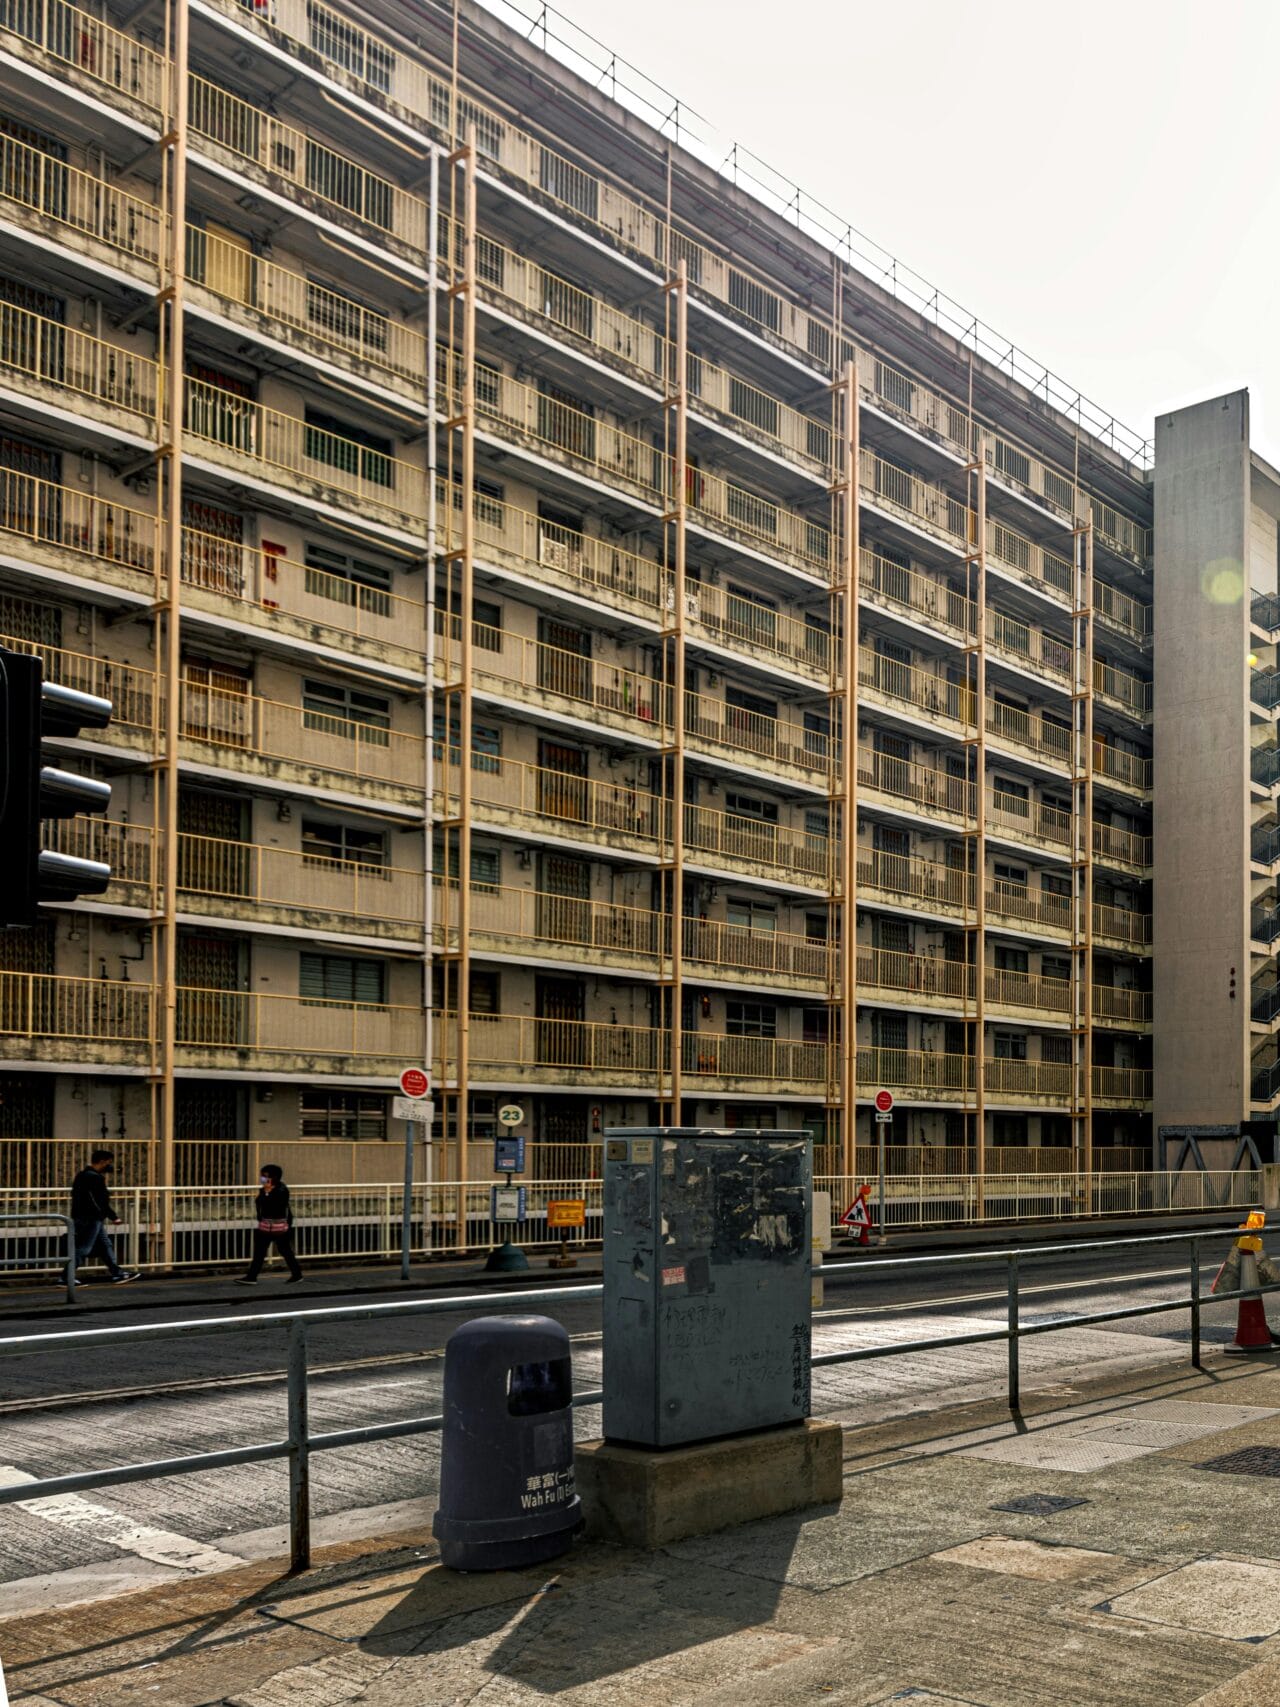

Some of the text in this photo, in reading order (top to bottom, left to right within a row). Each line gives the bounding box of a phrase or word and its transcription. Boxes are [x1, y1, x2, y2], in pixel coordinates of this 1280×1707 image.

[502, 1110, 520, 1121] 23
[521, 1491, 543, 1509] Wah
[545, 1490, 556, 1504] Fu
